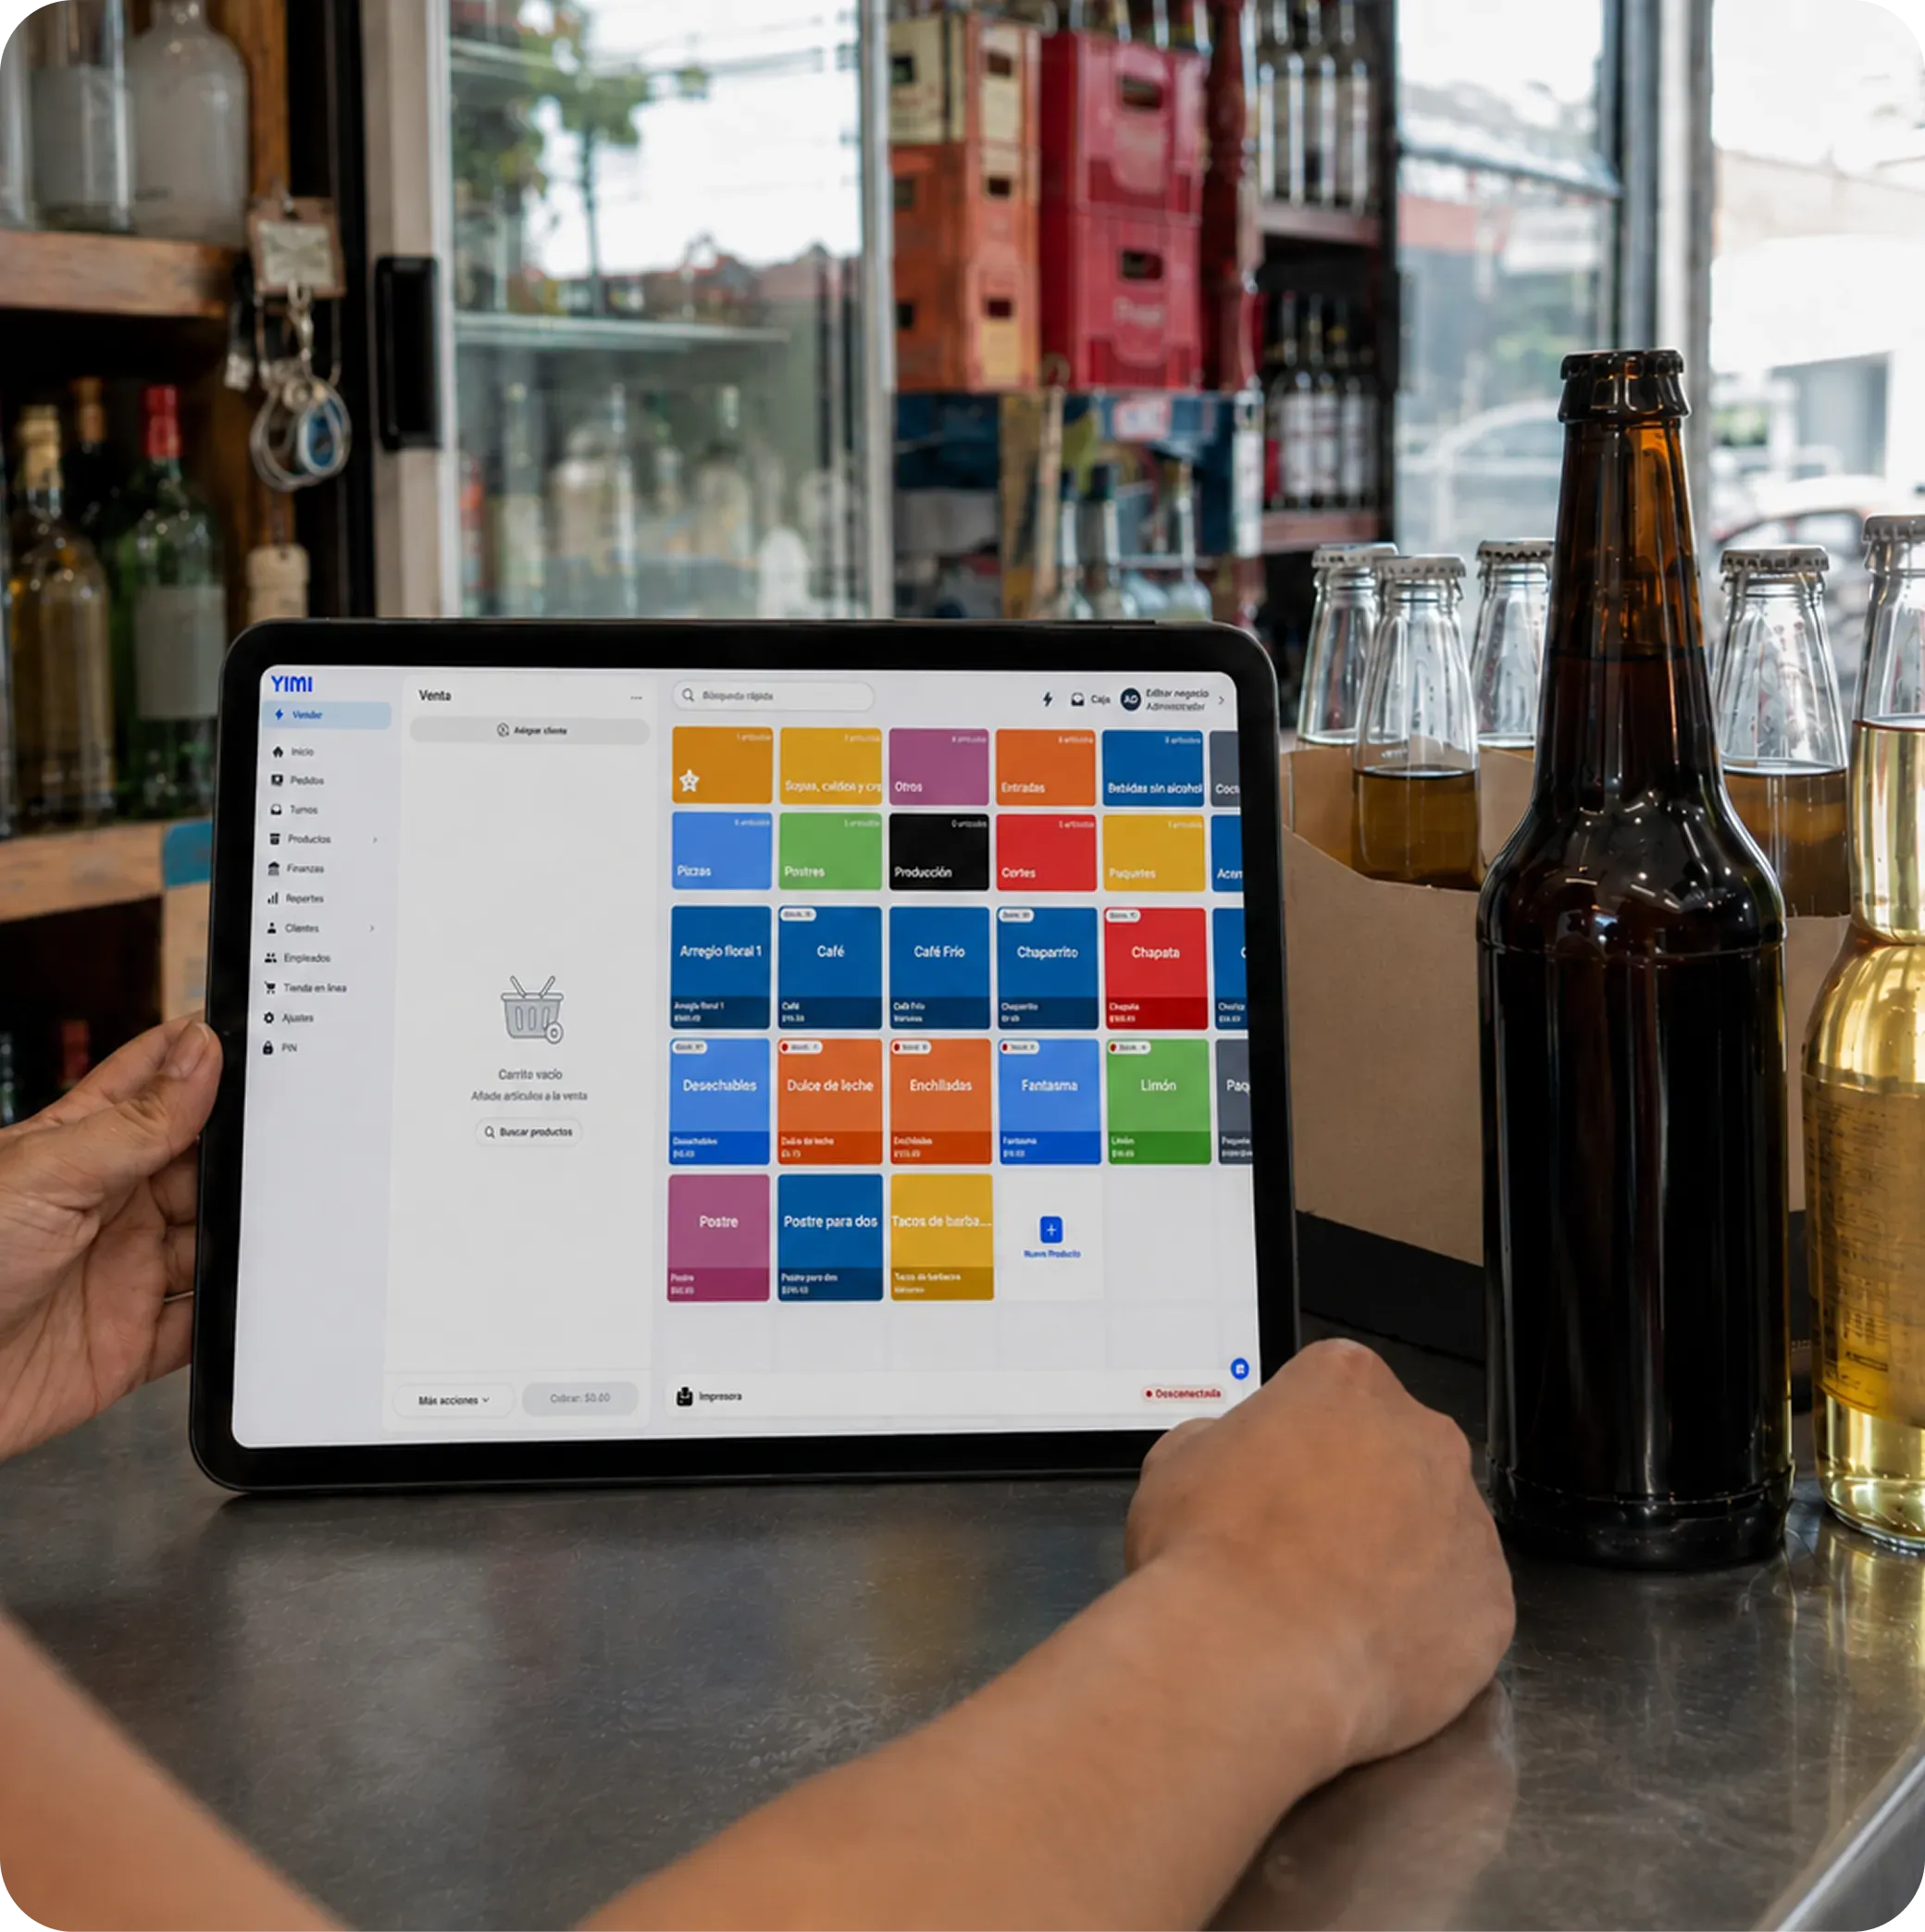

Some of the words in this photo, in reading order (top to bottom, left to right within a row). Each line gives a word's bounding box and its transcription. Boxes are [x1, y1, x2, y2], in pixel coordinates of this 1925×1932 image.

[270, 675, 313, 693] YIMI
[418, 688, 453, 702] Venta
[1090, 694, 1111, 707] Caja
[291, 746, 315, 757] Inicio
[290, 774, 325, 786] Pedidos
[894, 781, 923, 793] Otros
[1000, 782, 1046, 794] Entradas
[1108, 783, 1148, 794] Bebidas
[1149, 783, 1166, 794] sin
[288, 834, 331, 846] Productos
[286, 863, 325, 875] Finanzas
[677, 865, 711, 878] Pizzas
[785, 866, 826, 878] Postres
[894, 866, 952, 879] Producción
[1000, 867, 1036, 879] Cortes
[1109, 868, 1156, 881] Paquetes
[285, 893, 324, 905] Reportes
[285, 923, 319, 934] Clientes
[725, 944, 754, 958] floral
[756, 945, 762, 957] 1
[817, 945, 845, 958] Café
[913, 946, 941, 959] Café
[1017, 946, 1078, 960] Chaparrito
[1131, 947, 1180, 960] Chapata
[283, 953, 331, 965] Empleados
[283, 983, 313, 993] Tienda
[281, 1012, 315, 1024] Ajustes
[281, 1043, 298, 1053] PIN
[498, 1068, 533, 1080] Carrito
[683, 1079, 756, 1092] Desechables
[788, 1079, 821, 1092] Dulce
[823, 1079, 838, 1092] de
[840, 1079, 874, 1092] leche
[910, 1079, 972, 1093] Enchiladas
[1022, 1079, 1078, 1092] Fantasma
[1141, 1079, 1176, 1092] Limón
[563, 1092, 588, 1101] venta
[500, 1127, 528, 1137] Buscar
[529, 1126, 573, 1138] productos
[700, 1215, 739, 1229] Postre
[784, 1215, 823, 1229] Postre
[825, 1217, 852, 1231] para
[854, 1215, 877, 1228] dos
[891, 1216, 925, 1228] Tacos
[927, 1216, 943, 1228] de
[440, 1394, 478, 1406] acciones
[699, 1392, 742, 1403] Impresora
